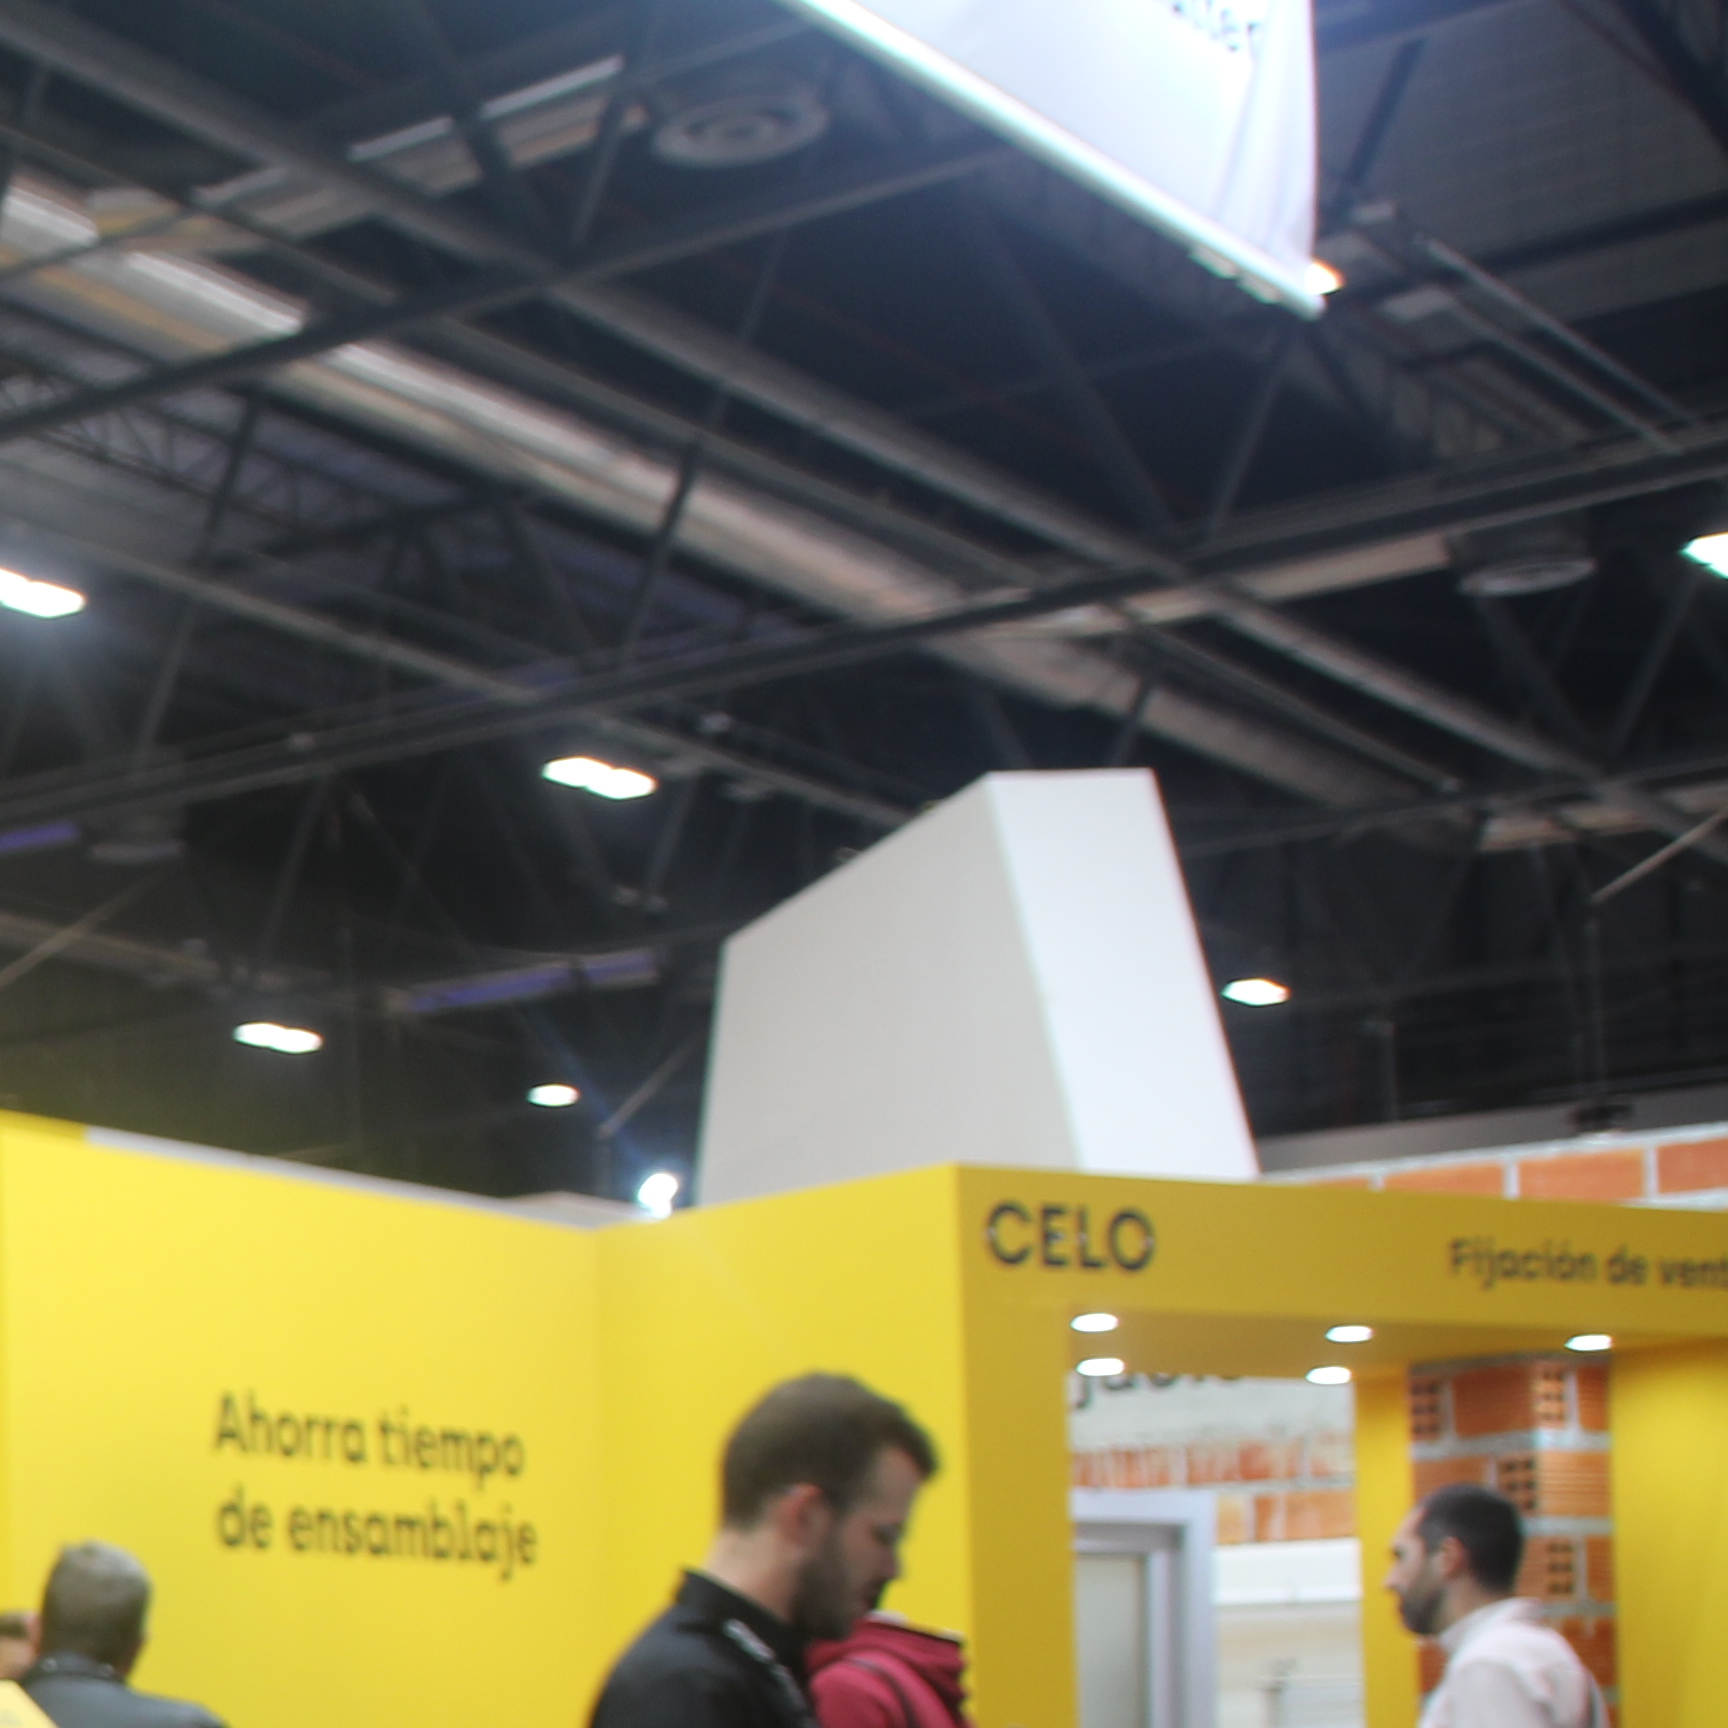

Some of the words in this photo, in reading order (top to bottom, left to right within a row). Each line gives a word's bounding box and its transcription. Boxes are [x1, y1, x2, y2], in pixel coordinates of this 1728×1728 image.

[984, 1200, 1155, 1271] CELO
[1450, 1236, 1598, 1291] Fijación
[1607, 1244, 1648, 1287] de
[213, 1389, 366, 1464] Ahorra
[378, 1404, 525, 1491] tiempo
[217, 1481, 272, 1549] de
[289, 1499, 539, 1582] ensamblaje
